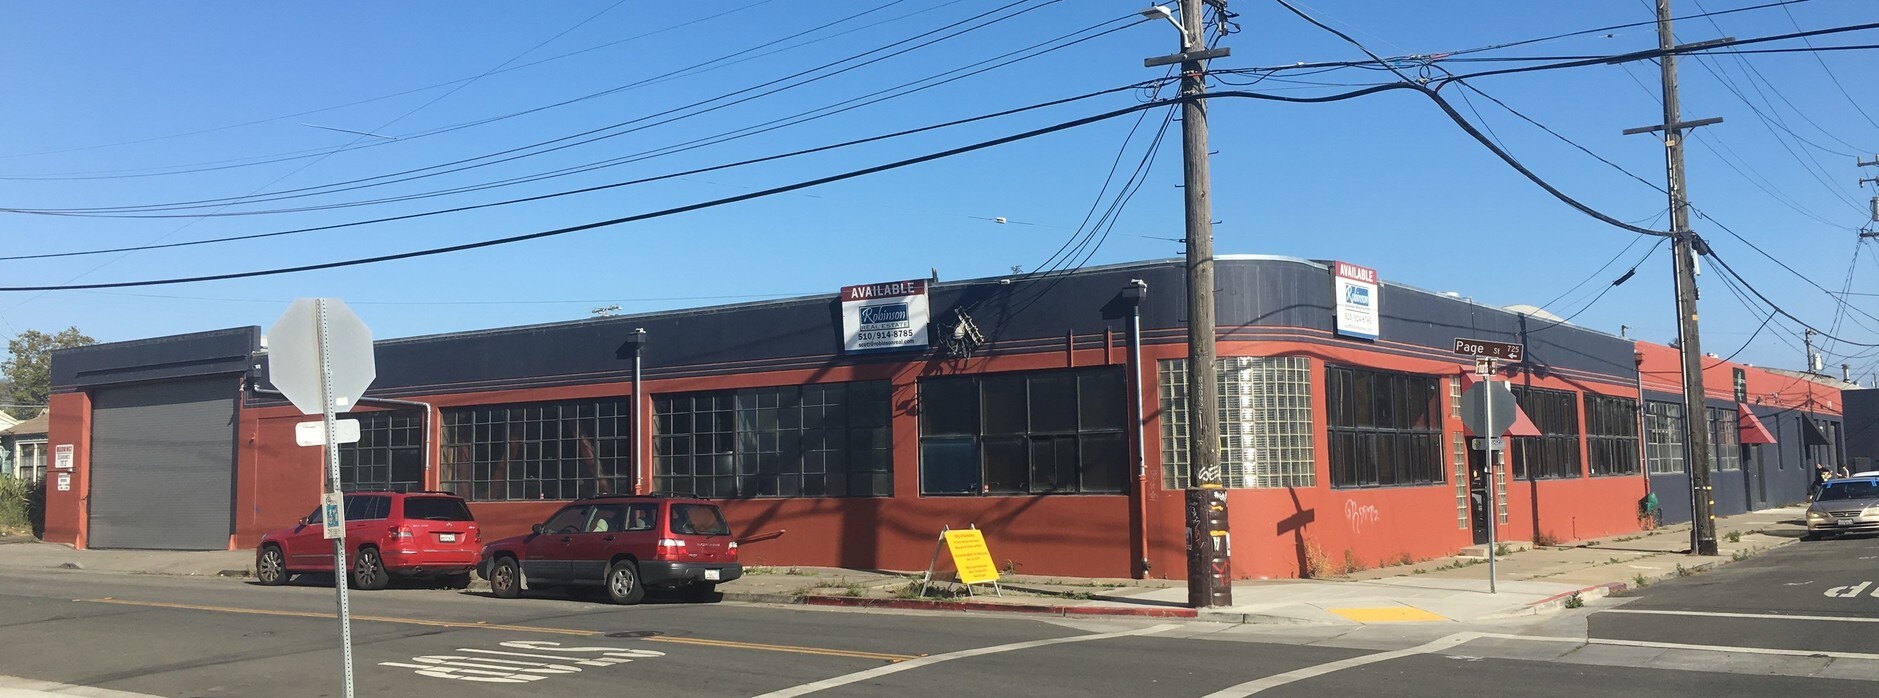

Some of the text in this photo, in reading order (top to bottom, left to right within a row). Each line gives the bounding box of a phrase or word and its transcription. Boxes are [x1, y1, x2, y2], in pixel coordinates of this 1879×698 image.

[1340, 263, 1374, 282] AVAILABLE
[851, 282, 915, 298] AVAILABLE
[862, 305, 906, 324] Robinson
[858, 329, 914, 341] 510/914-8785
[1456, 340, 1520, 356] Page St 725
[378, 641, 666, 683] STOP
